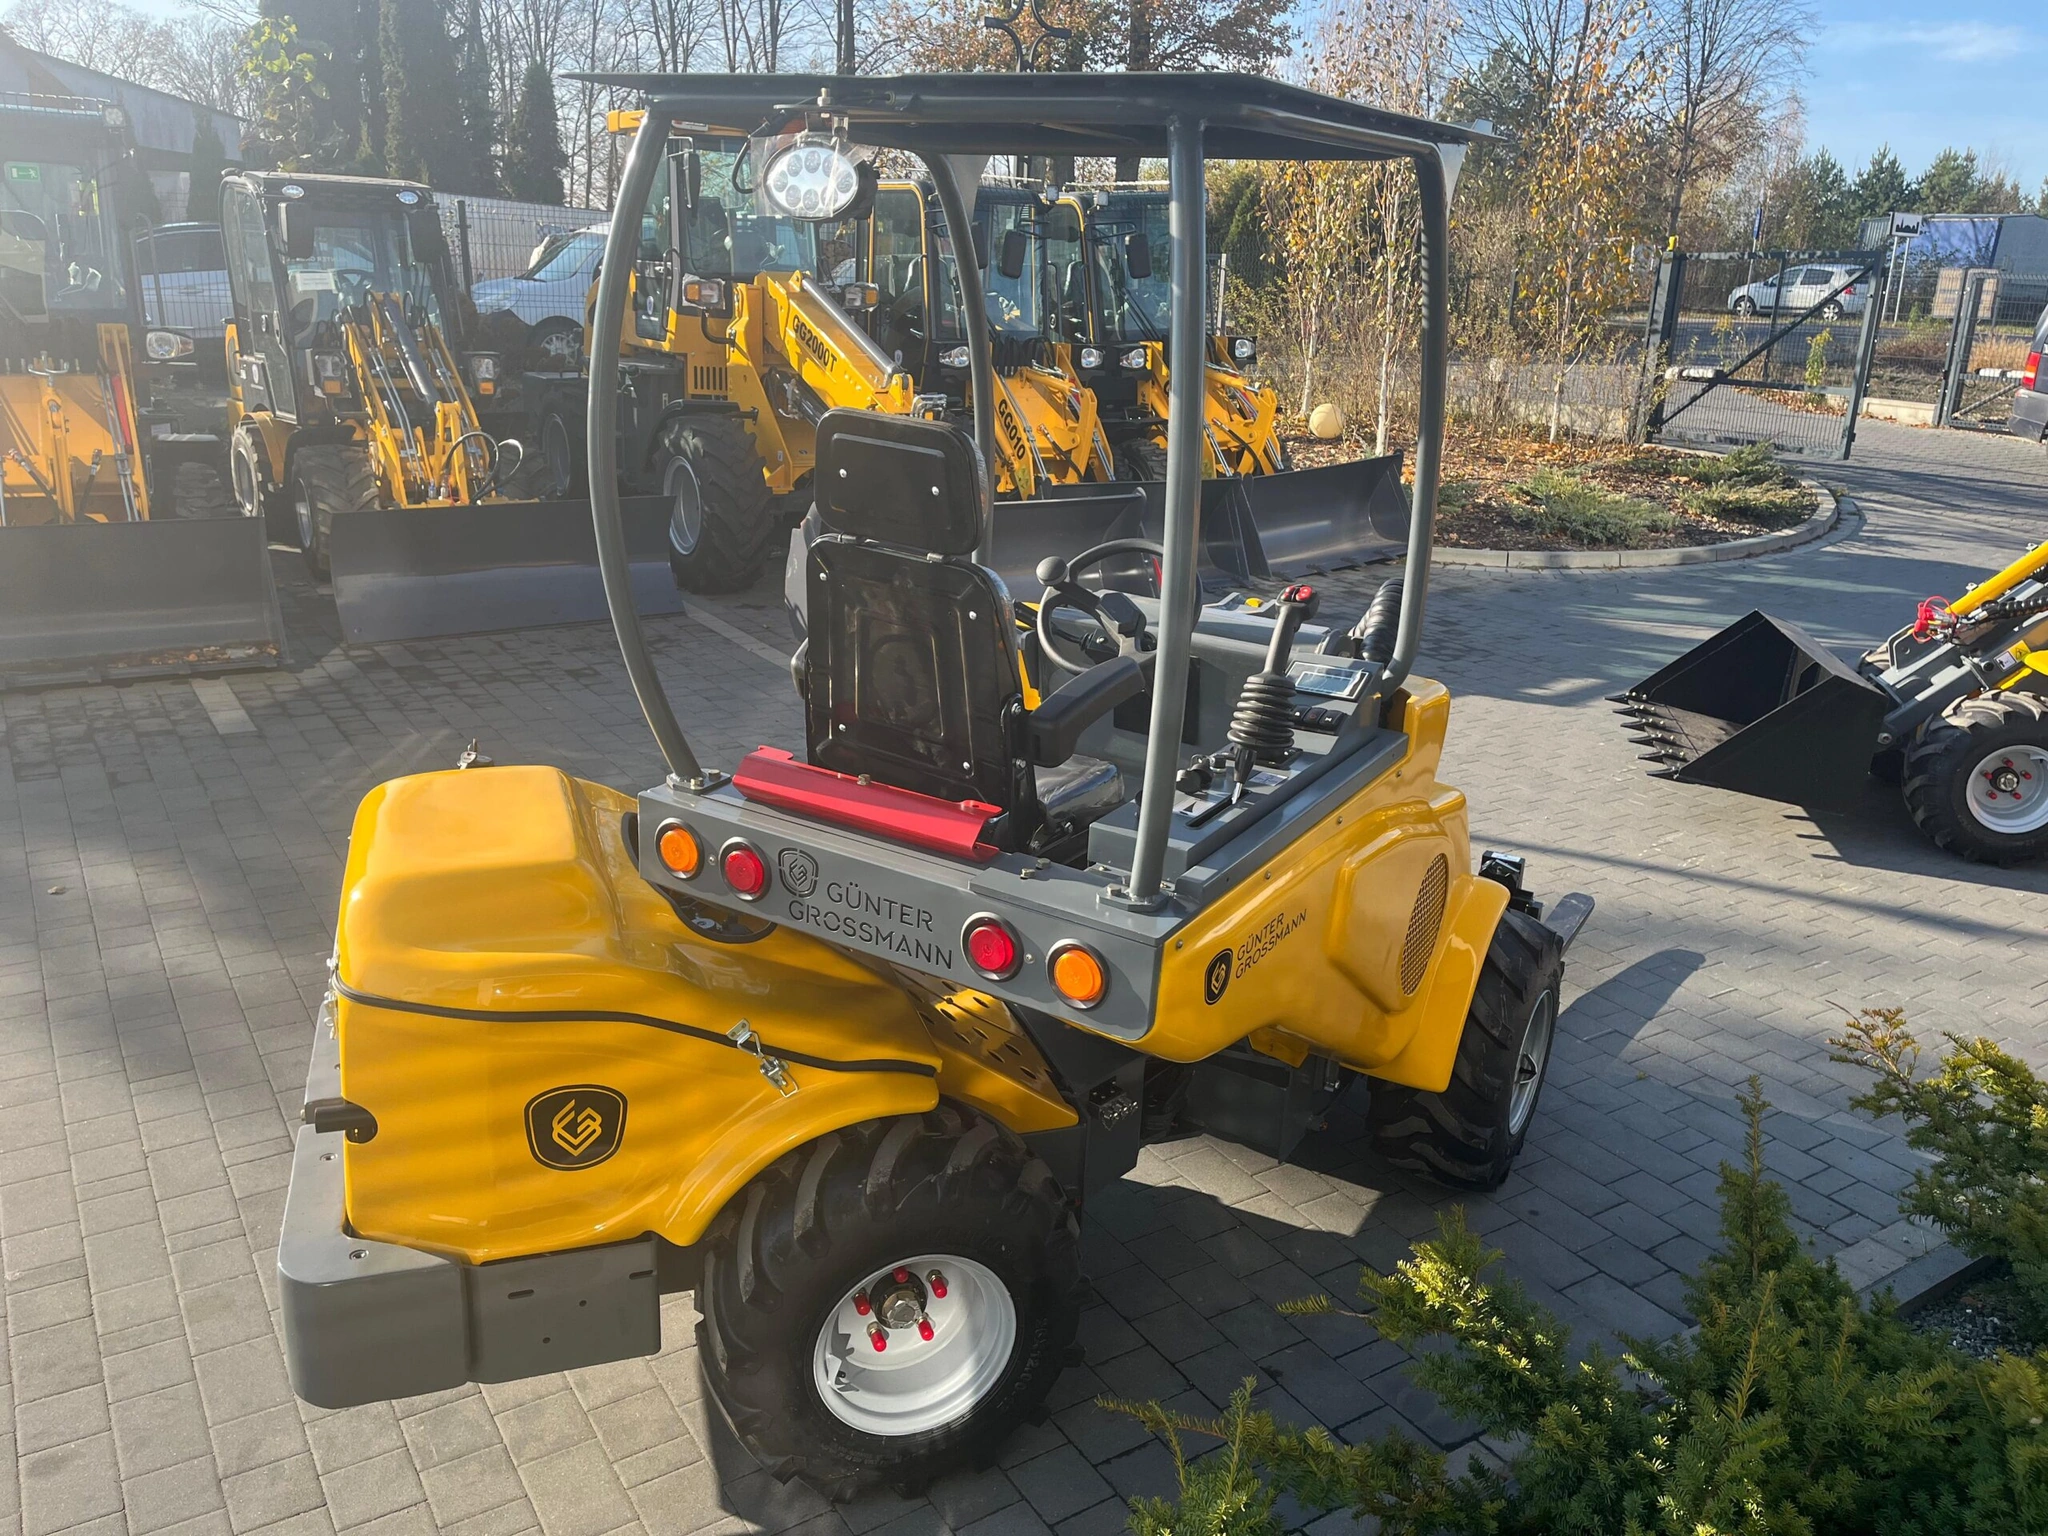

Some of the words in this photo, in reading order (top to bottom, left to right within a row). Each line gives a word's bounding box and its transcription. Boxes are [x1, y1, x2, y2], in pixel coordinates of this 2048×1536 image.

[792, 314, 838, 373] GG2000T
[998, 398, 1026, 461] GG010
[788, 900, 953, 970] GROSSMANN
[827, 881, 933, 933] GÜNTER
[1236, 912, 1285, 962] GÜNTER
[1235, 908, 1308, 979] GROSSMANN
